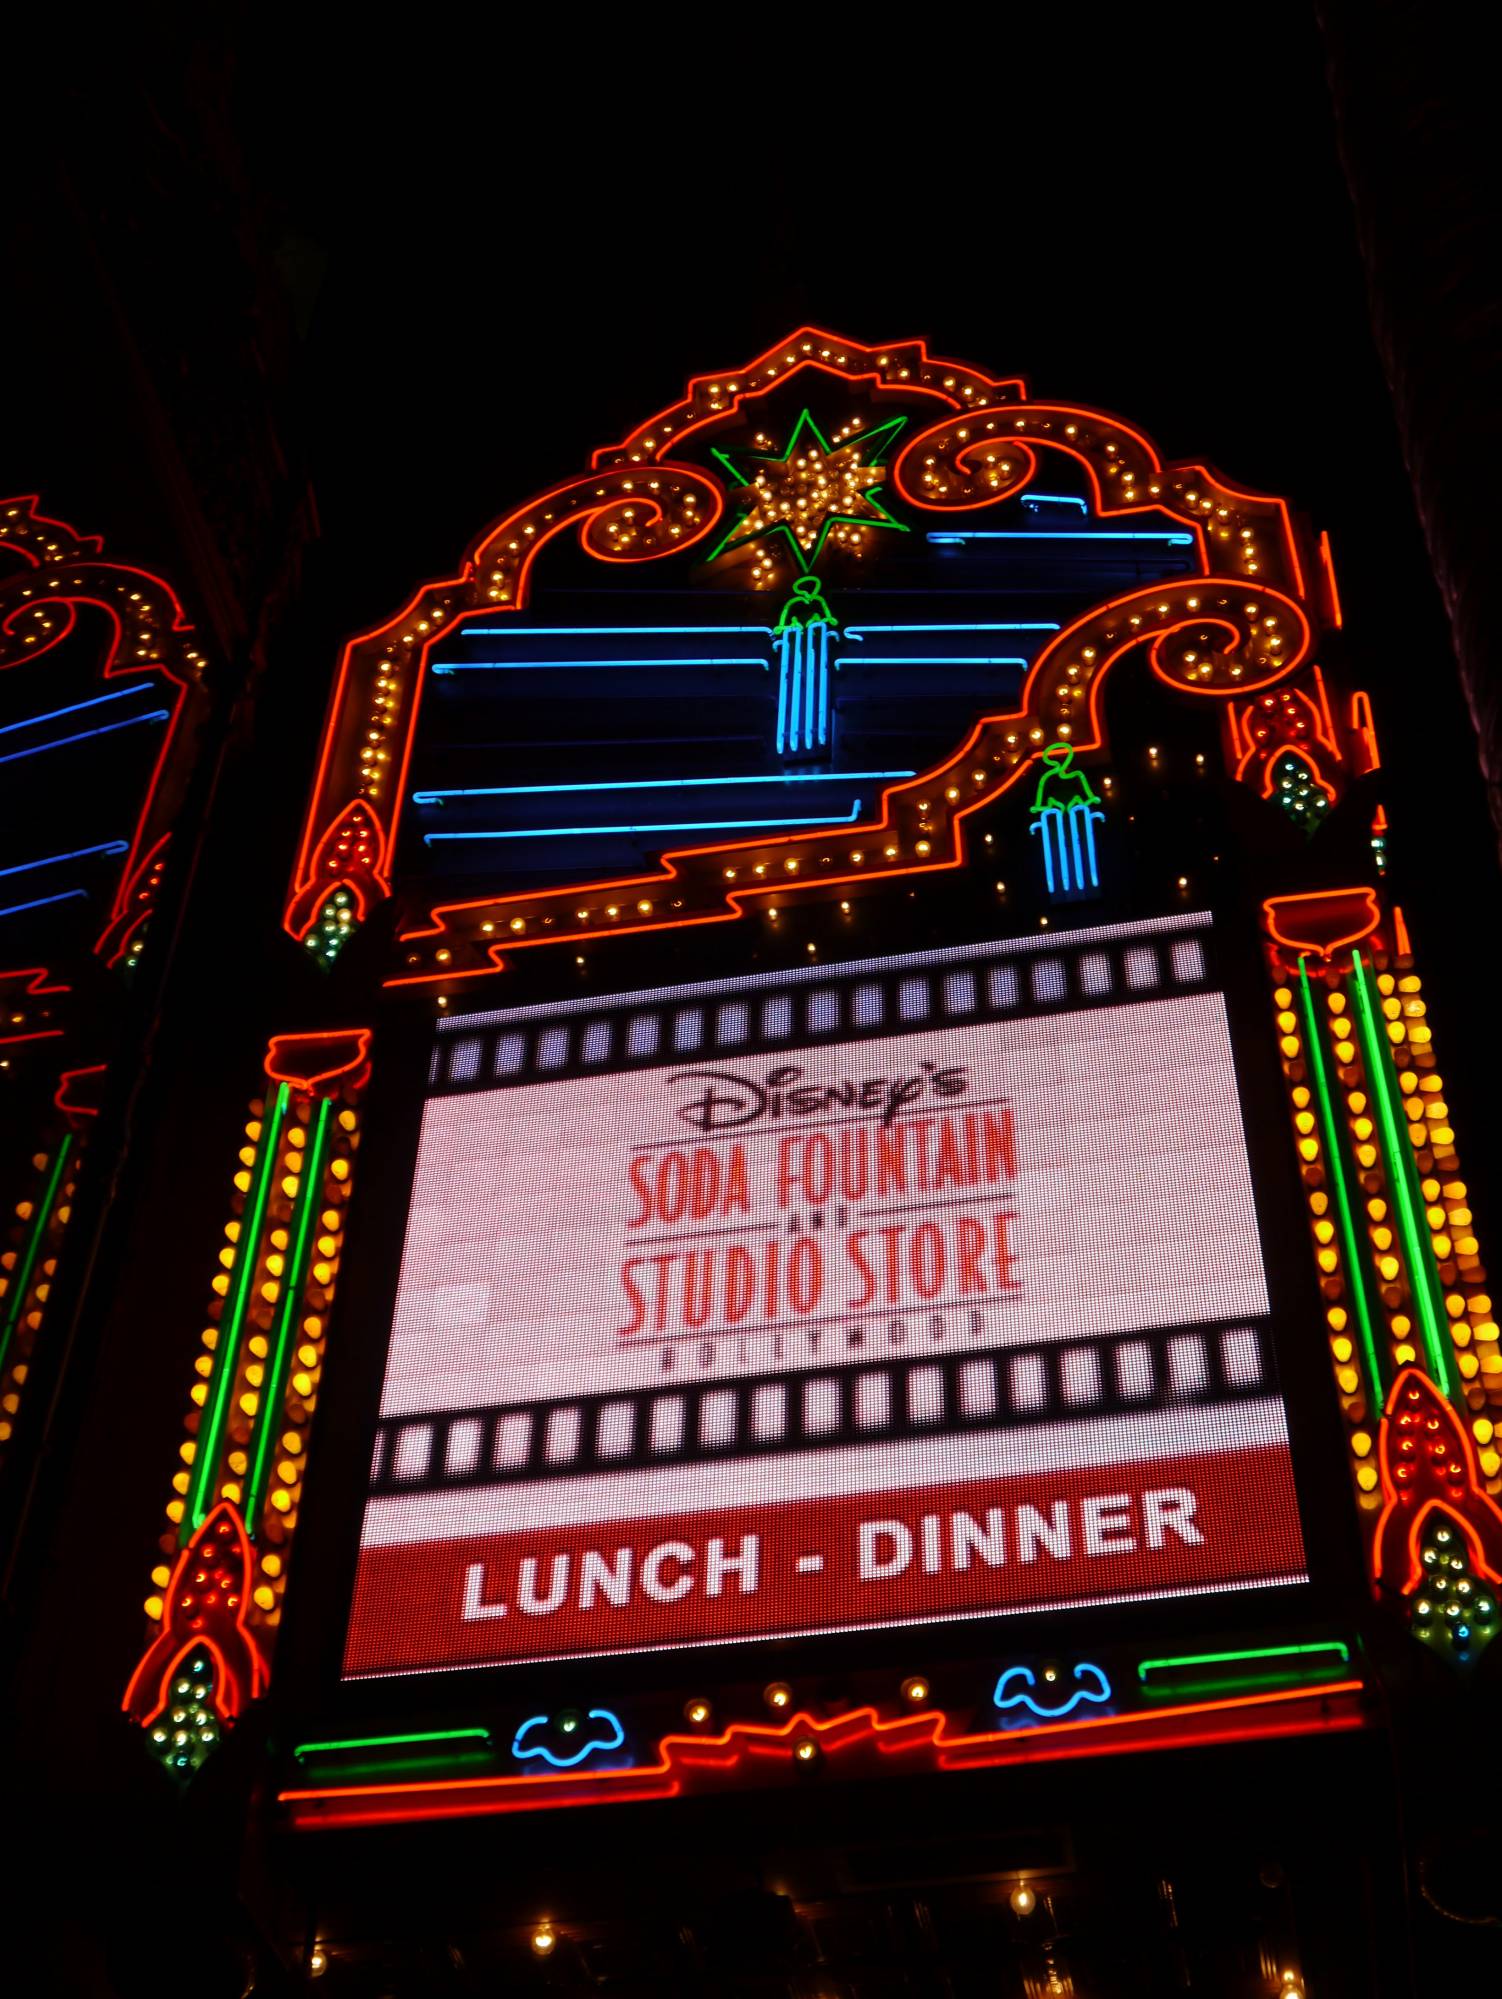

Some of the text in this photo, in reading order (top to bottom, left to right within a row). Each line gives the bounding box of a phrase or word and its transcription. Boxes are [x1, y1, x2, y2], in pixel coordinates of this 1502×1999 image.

[665, 1062, 969, 1132] Disney's
[627, 1108, 1019, 1228] SODA FOUNTAIN
[617, 1211, 1022, 1336] STUDIO STORE
[461, 1486, 1206, 1623] LUNCH - DINNER
